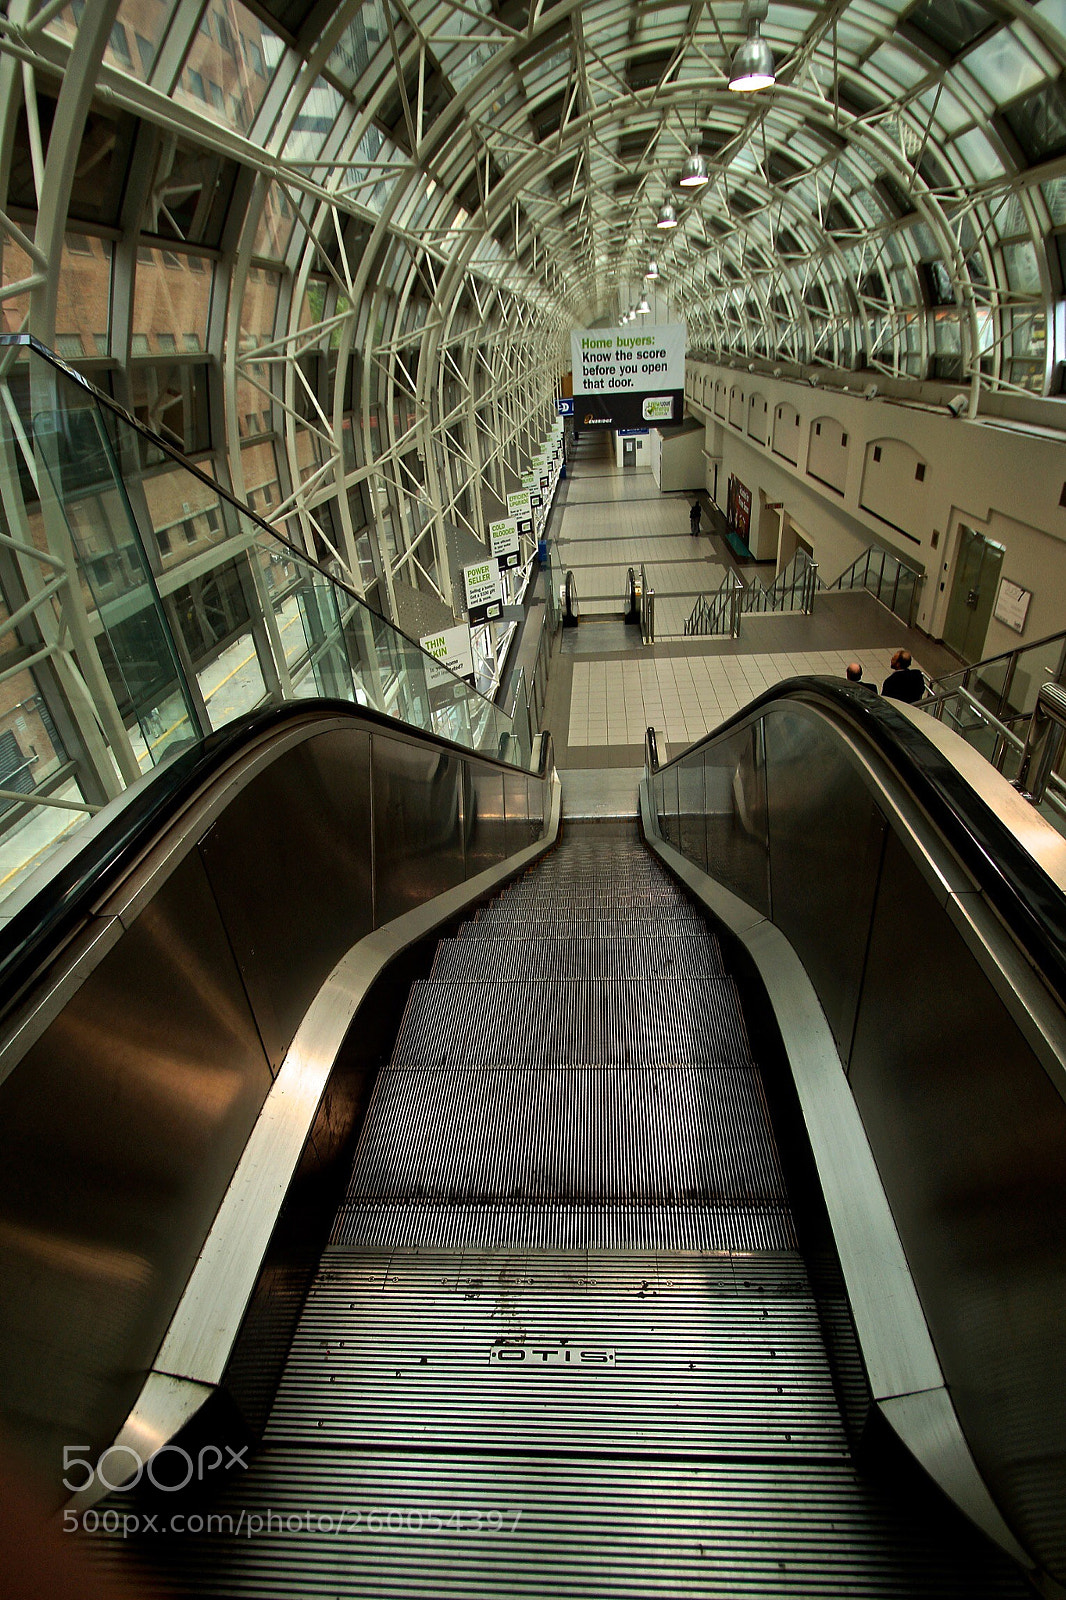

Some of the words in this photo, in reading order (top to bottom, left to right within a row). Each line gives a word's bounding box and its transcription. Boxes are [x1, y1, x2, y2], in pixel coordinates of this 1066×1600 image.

[582, 338, 612, 349] Home
[616, 336, 655, 348] buyers:
[582, 352, 612, 362] Know
[615, 350, 632, 360] the
[636, 349, 666, 359] score
[582, 365, 616, 376] before
[620, 365, 638, 376] you
[642, 362, 668, 374] open
[583, 378, 604, 389] that
[608, 378, 634, 388] door.
[493, 528, 515, 538] BLOODED
[468, 565, 490, 578] POWER
[468, 573, 490, 586] SELLER
[425, 636, 445, 650] THIN
[498, 1350, 608, 1362] OTIS
